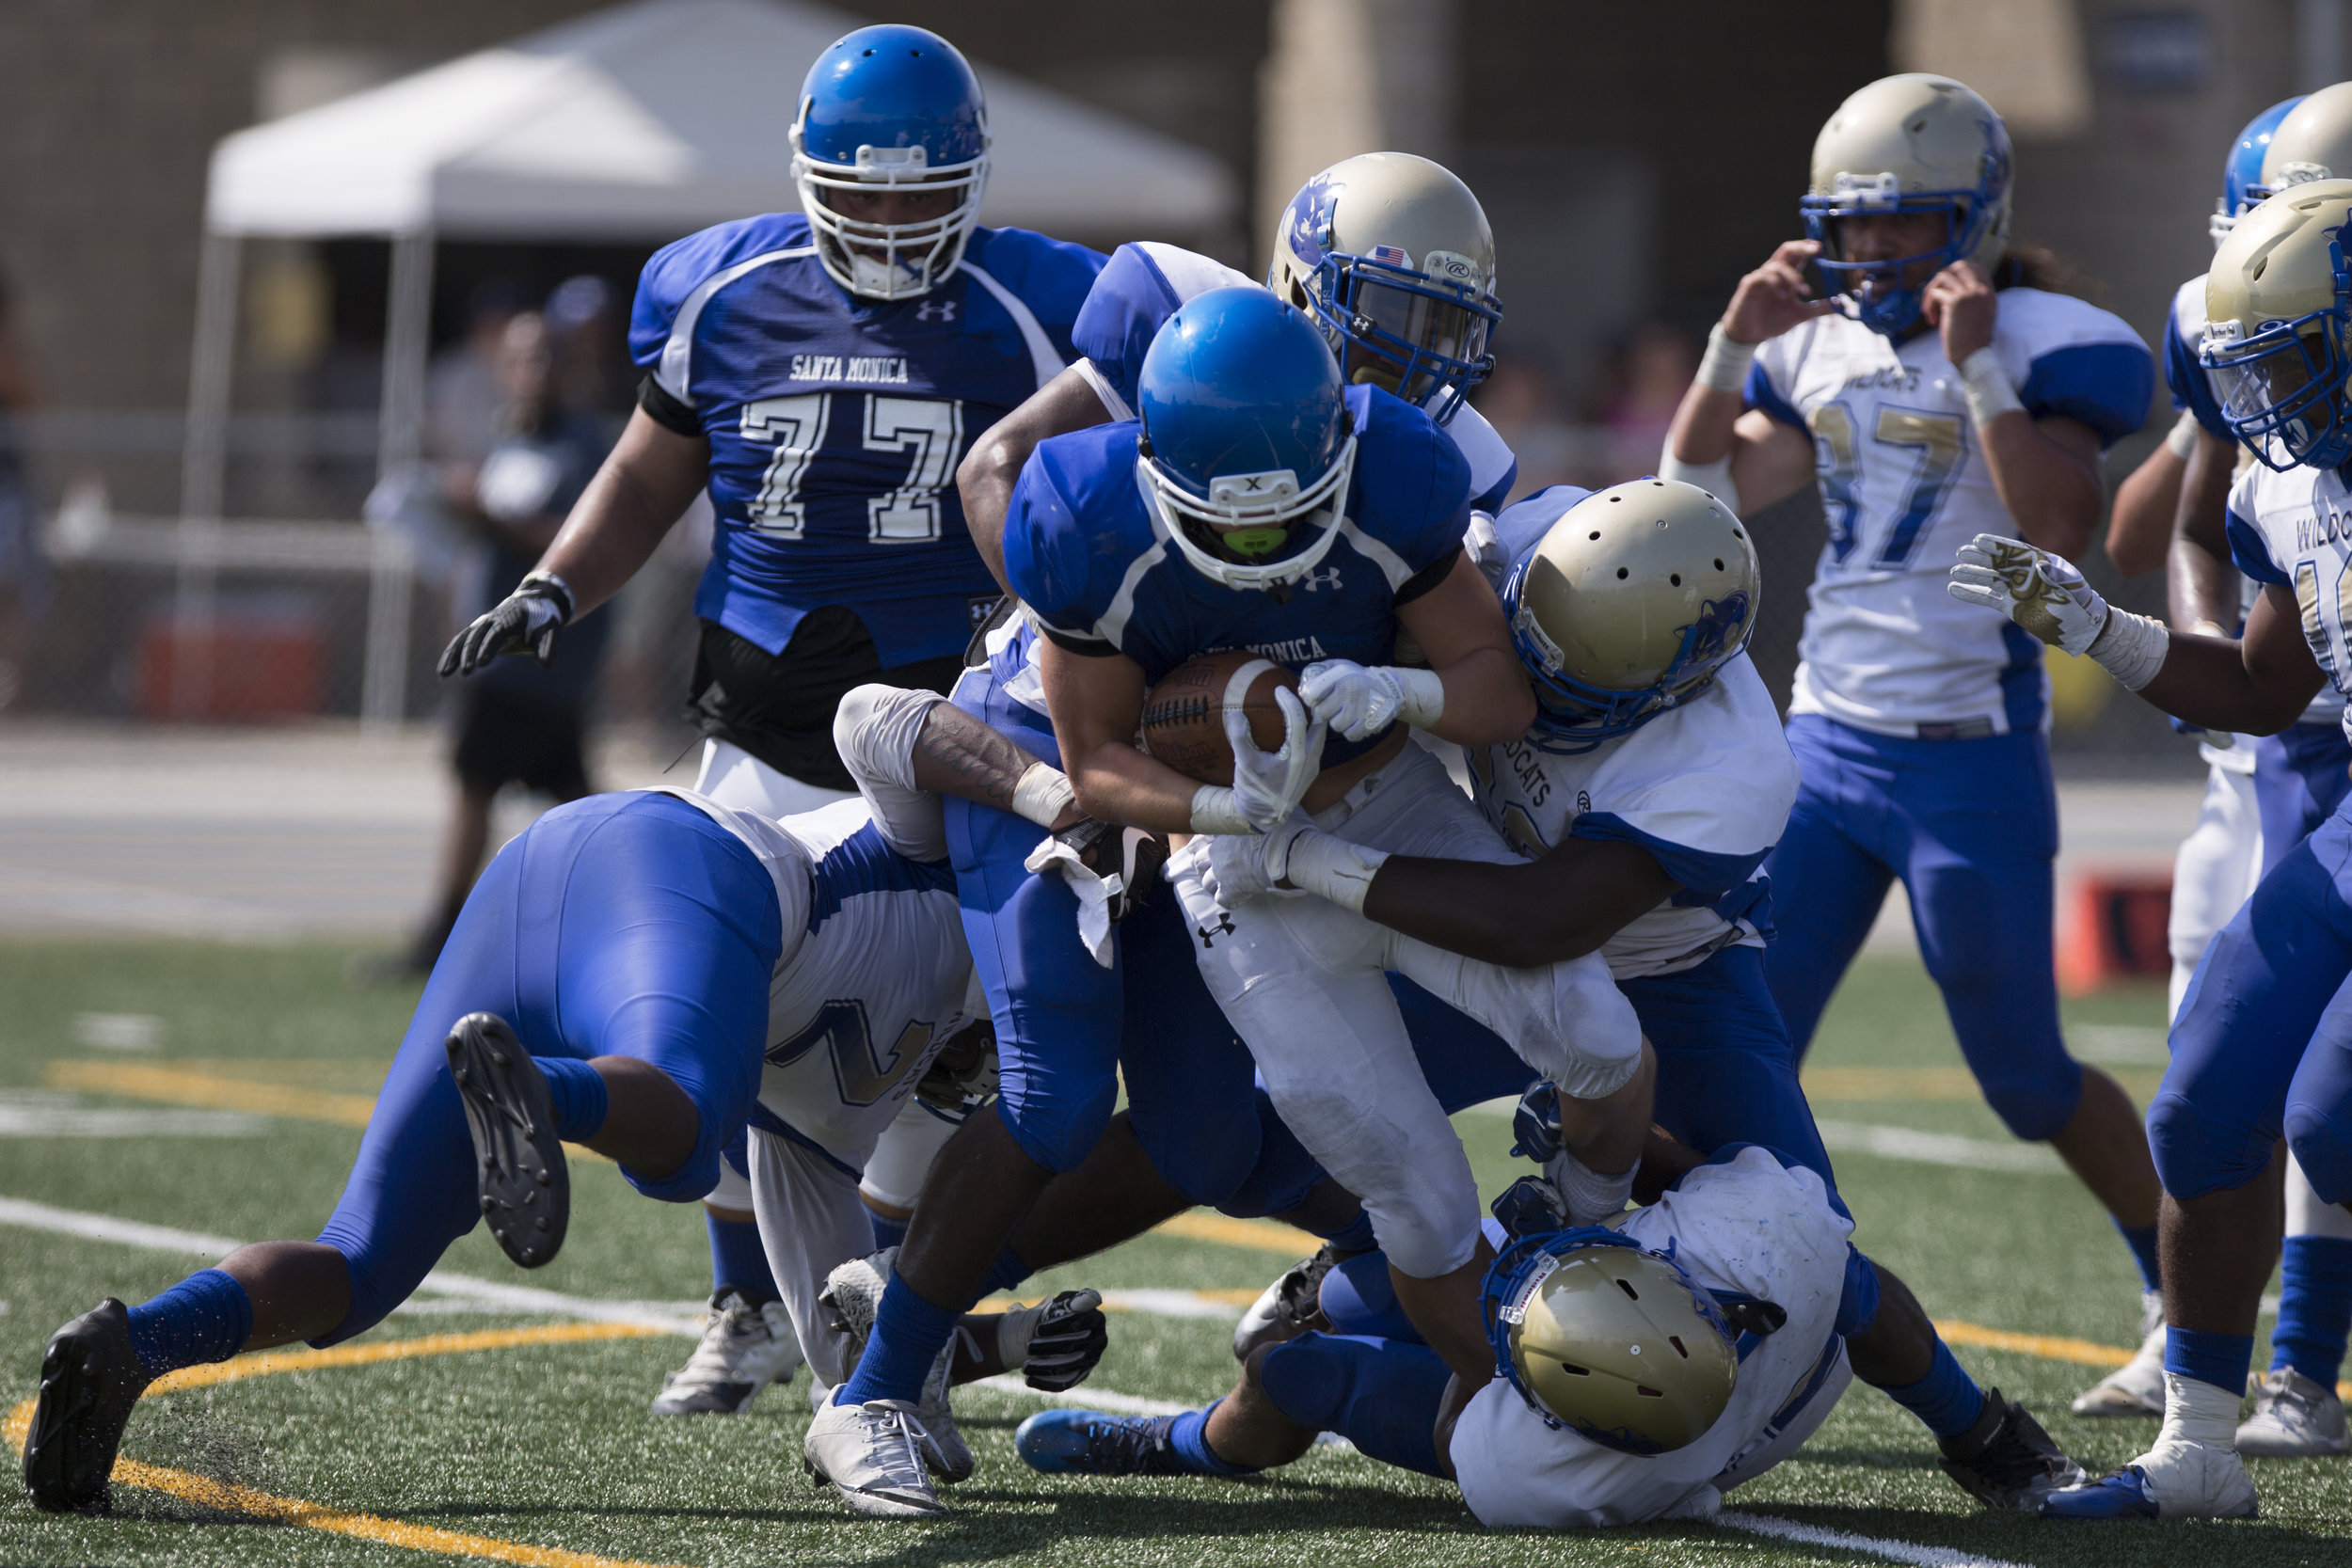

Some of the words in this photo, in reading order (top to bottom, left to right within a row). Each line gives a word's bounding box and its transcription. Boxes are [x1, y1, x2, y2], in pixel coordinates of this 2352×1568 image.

[1320, 289, 1333, 340] ADMS
[789, 355, 842, 381] SANTA
[845, 357, 908, 383] MONICA
[739, 392, 964, 545] 77
[1244, 476, 1263, 491] X
[1503, 740, 1551, 808] DCATS
[764, 999, 935, 1108] 2
[893, 1009, 964, 1102] WILDCATS
[1520, 1272, 1547, 1308] Riddell
